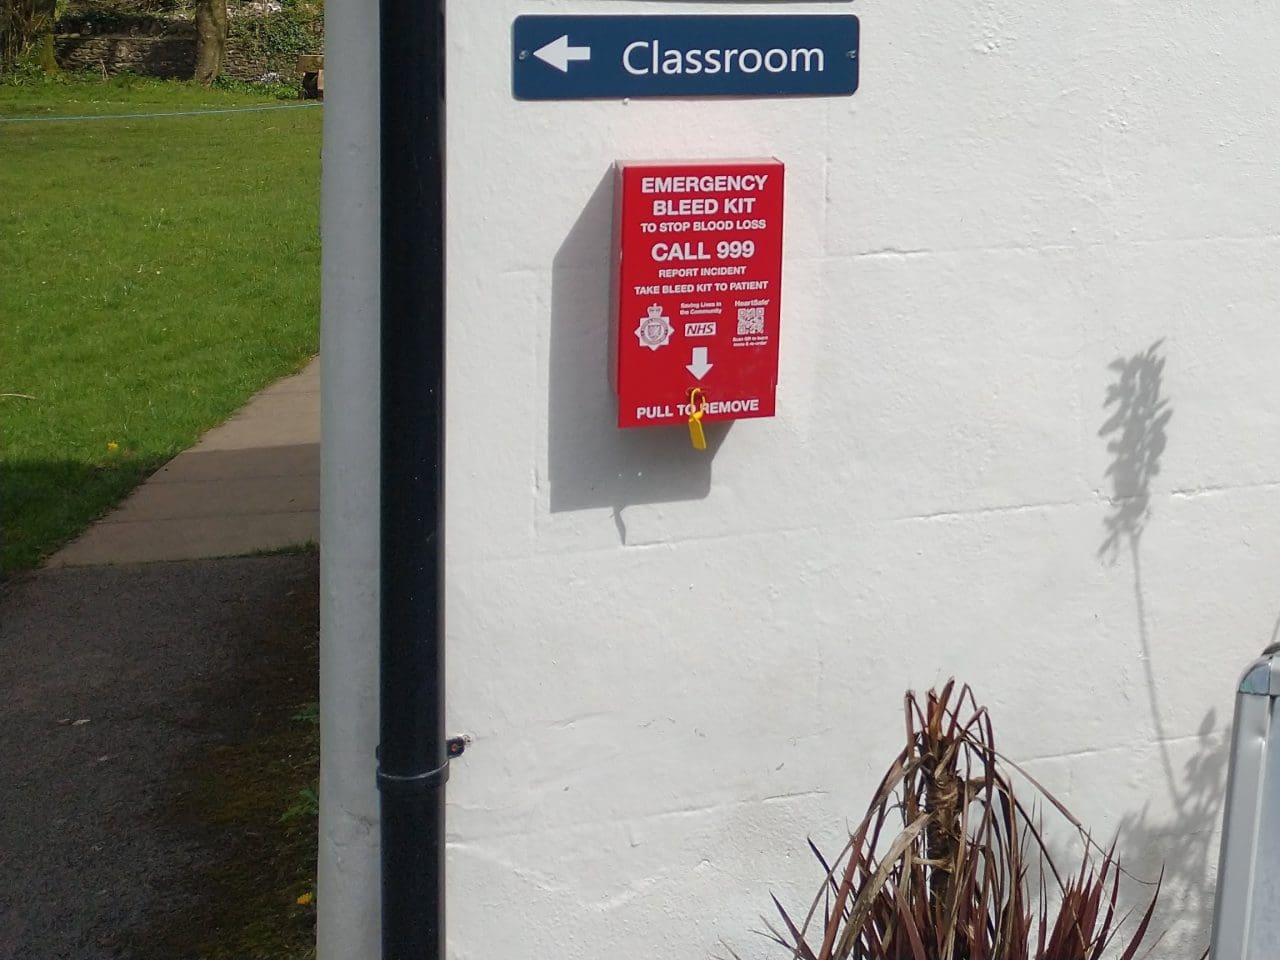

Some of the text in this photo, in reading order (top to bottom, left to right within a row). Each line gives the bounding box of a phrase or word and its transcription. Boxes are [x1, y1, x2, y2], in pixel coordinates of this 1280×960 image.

[622, 40, 824, 75] Classroom
[641, 175, 769, 193] EMERGENCY
[653, 197, 756, 216] BLEED KIT
[640, 219, 767, 233] TO STOP BLOOD LOSS
[651, 240, 755, 262] CALL 999
[658, 266, 747, 278] REPORT INCIDENT
[634, 281, 769, 296] TAKE BLEED KIT TO PATIENT
[686, 323, 714, 335] NHS
[636, 399, 759, 419] PULL TO REMOVE
